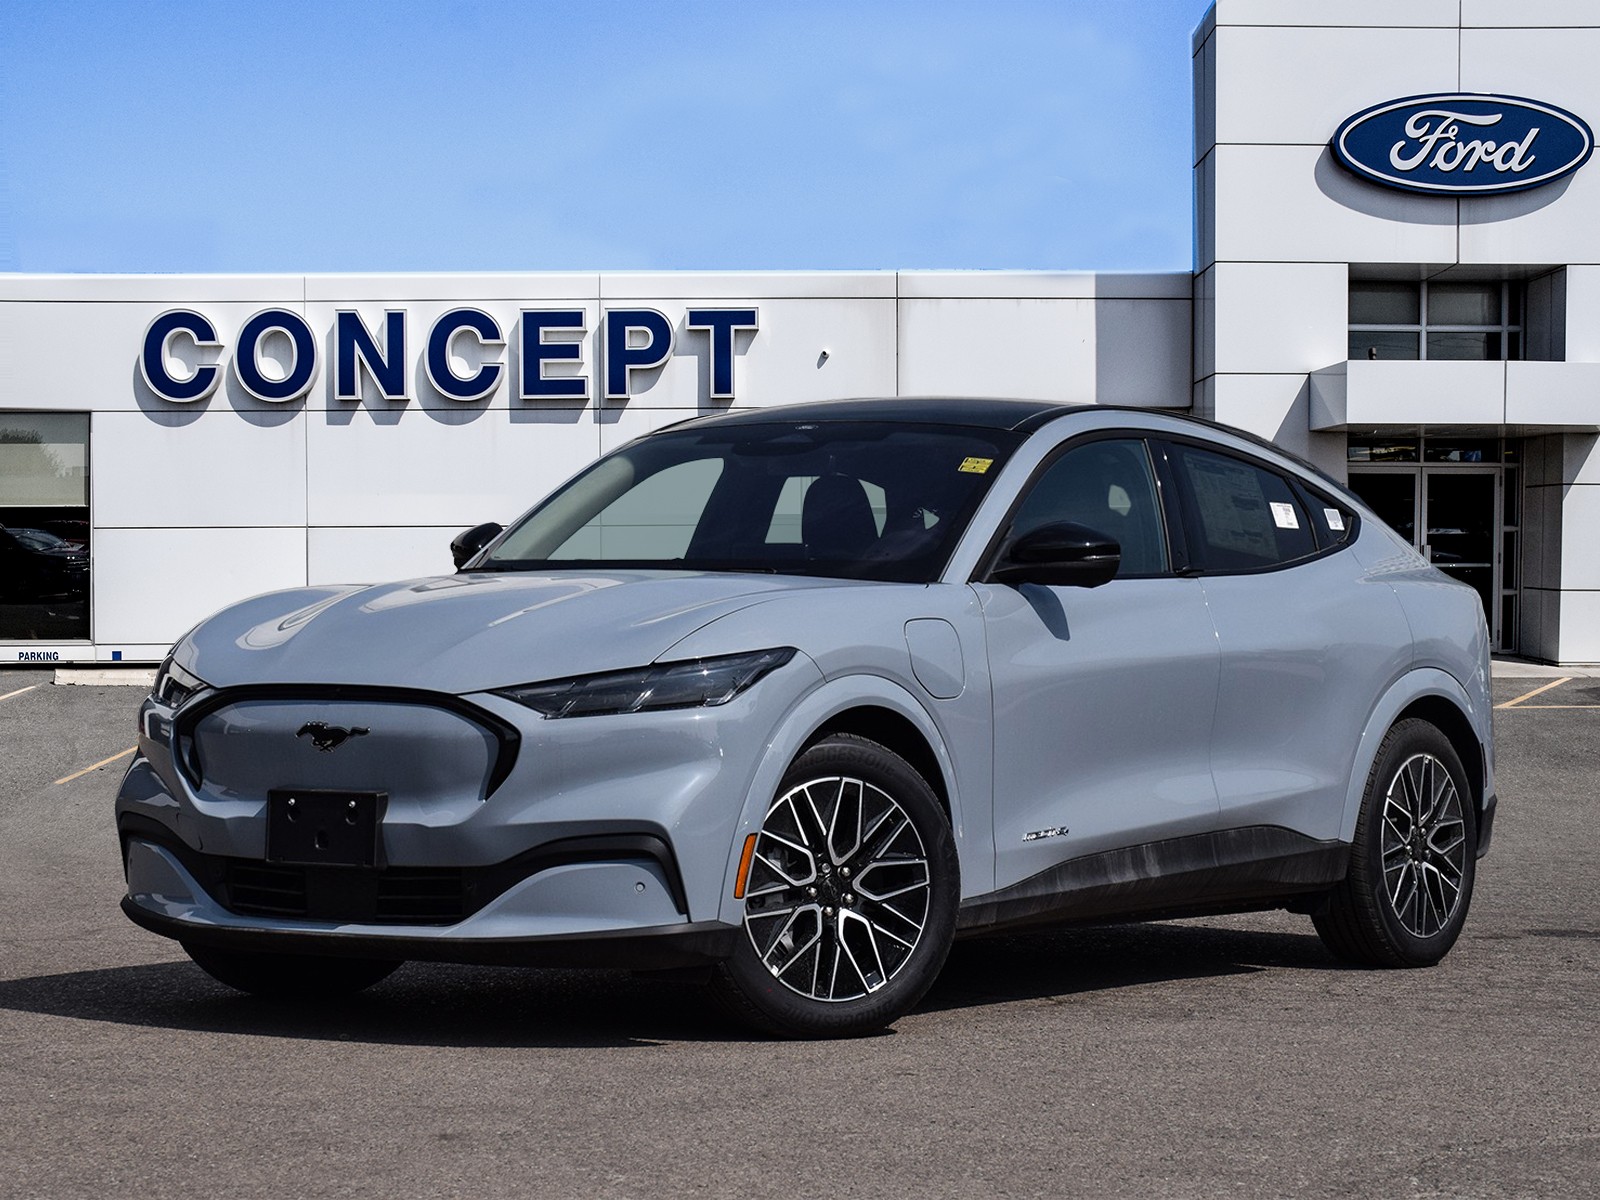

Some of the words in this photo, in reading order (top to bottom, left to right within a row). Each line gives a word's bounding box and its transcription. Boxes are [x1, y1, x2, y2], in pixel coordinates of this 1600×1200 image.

[1389, 110, 1540, 172] Ford
[140, 307, 759, 403] CONCEPT
[18, 651, 60, 661] PARKING
